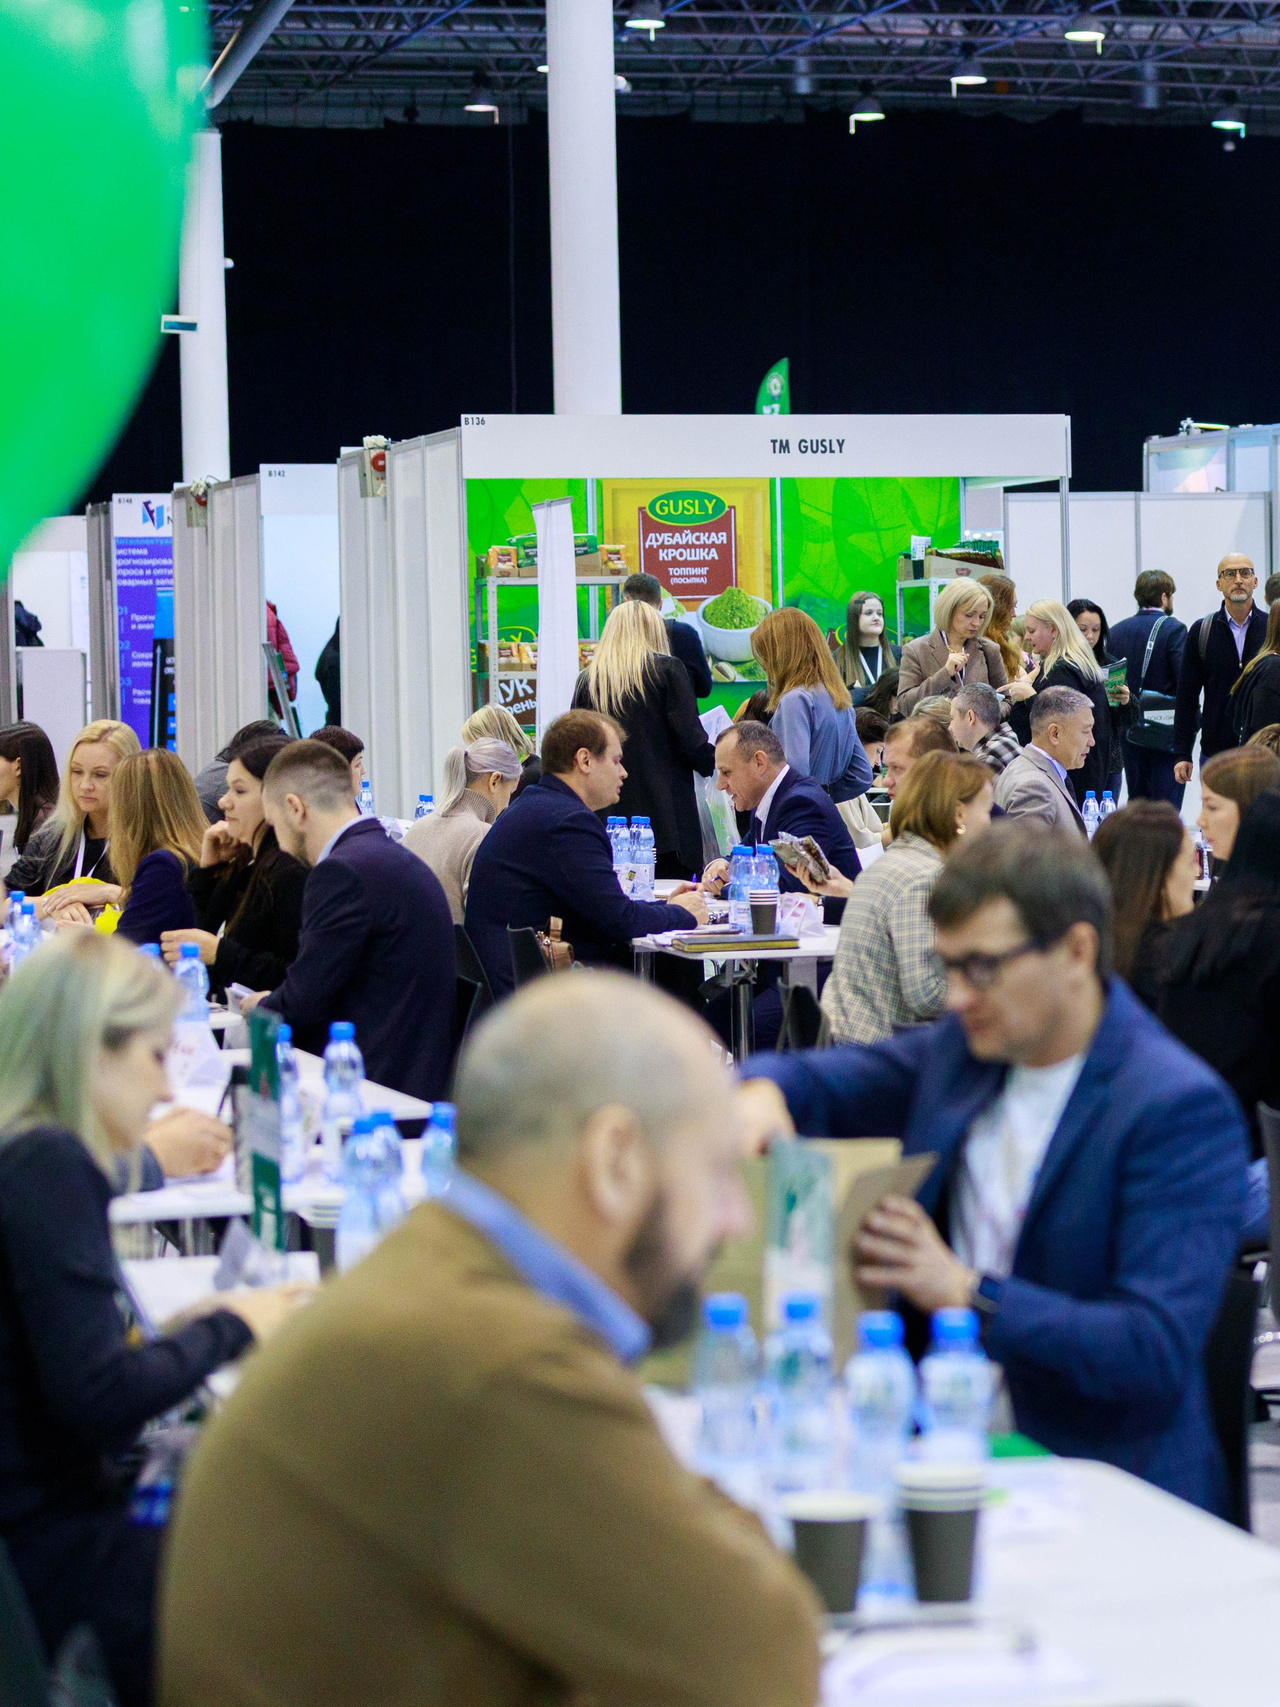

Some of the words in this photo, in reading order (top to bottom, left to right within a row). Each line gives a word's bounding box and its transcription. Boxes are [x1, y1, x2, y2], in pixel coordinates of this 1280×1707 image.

[464, 417, 486, 426] B136
[770, 439, 791, 454] TM
[798, 439, 846, 454] GUSLY
[655, 499, 716, 515] GUSLY
[645, 529, 727, 549] ДУБАЙСКАЯ
[116, 548, 148, 556] истема
[659, 548, 719, 561] КРОШКА
[117, 568, 144, 577] проса
[668, 567, 709, 575] ТОППИНГ
[117, 578, 153, 587] оварных
[670, 577, 707, 585] (ПОСЫПКА)
